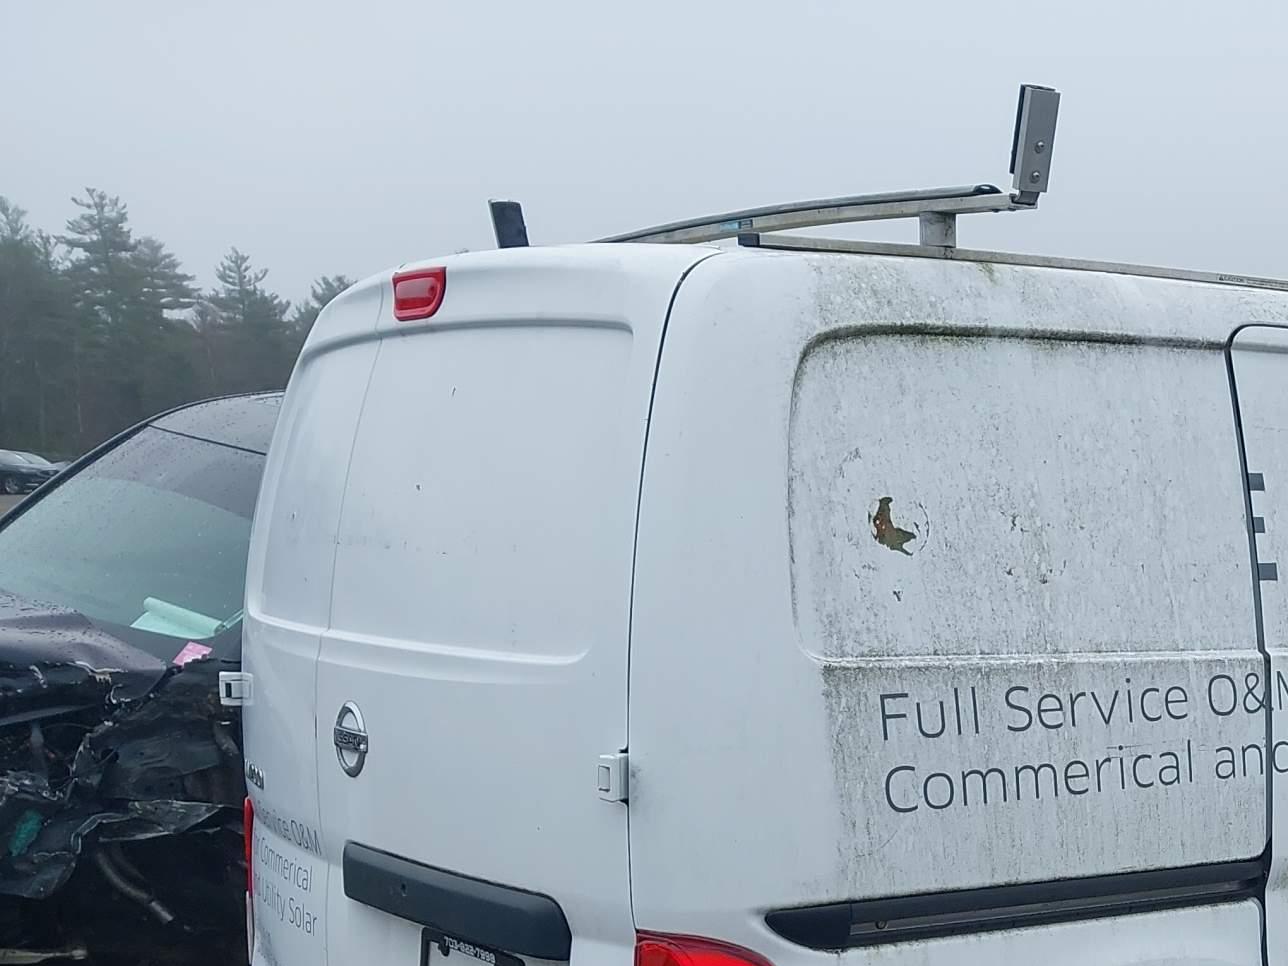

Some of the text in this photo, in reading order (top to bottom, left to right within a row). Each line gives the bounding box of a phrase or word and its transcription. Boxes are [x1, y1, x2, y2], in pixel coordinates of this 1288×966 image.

[879, 686, 980, 741] Full
[1004, 677, 1189, 733] Service
[884, 738, 1194, 814] Commerical
[290, 819, 322, 857] O&M
[287, 896, 318, 937] Solar
